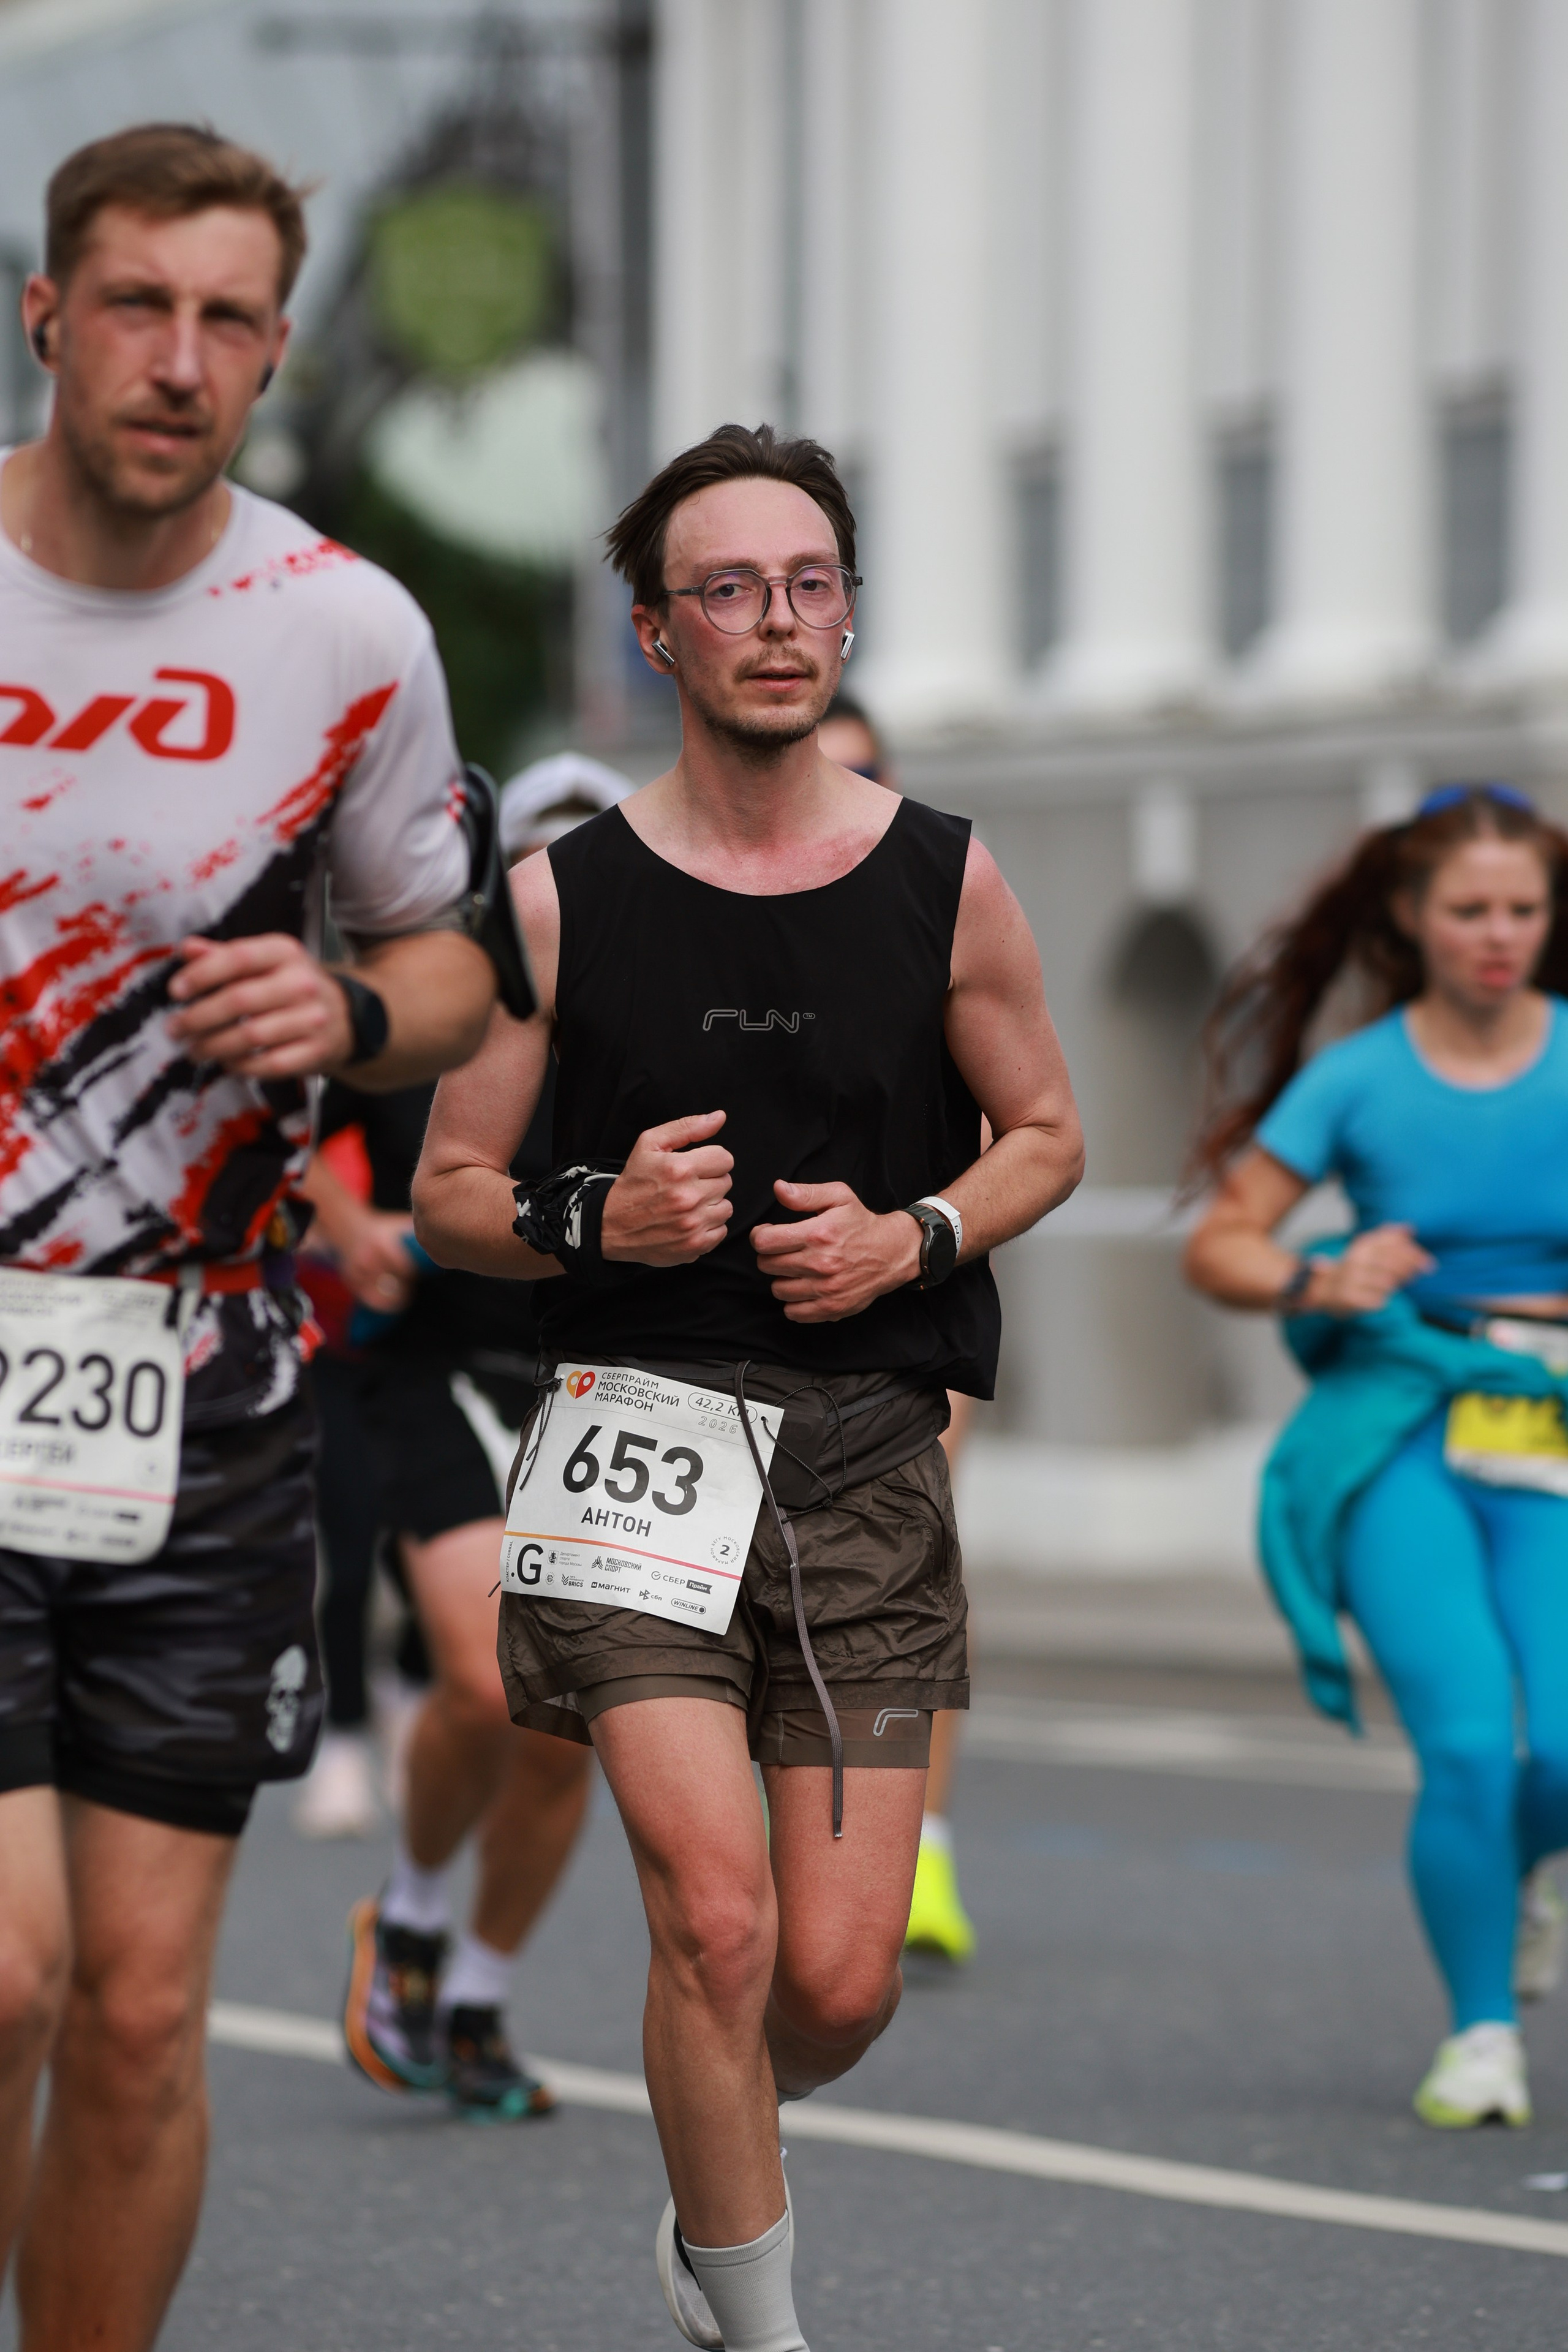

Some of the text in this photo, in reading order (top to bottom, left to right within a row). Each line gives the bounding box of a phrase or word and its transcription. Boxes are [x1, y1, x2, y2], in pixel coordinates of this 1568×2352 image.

[601, 1372, 659, 1389] СБЕРПРАЙМ
[0, 1348, 165, 1438] 230
[594, 1392, 654, 1412] МАРАФОН
[597, 1381, 680, 1407] МОСКОВСКИЙ
[695, 1397, 724, 1412] 42,2
[698, 1415, 738, 1434] 2026
[563, 1425, 704, 1516] 653
[581, 1506, 652, 1537] АНТОН
[720, 1544, 730, 1556] 2
[517, 1543, 544, 1585] G
[605, 1564, 622, 1573] СПОРТ
[606, 1557, 642, 1571] МОСКОВСКИЙ
[663, 1575, 707, 1591] СБЕР Прайм
[673, 1599, 699, 1611] WINLINE
